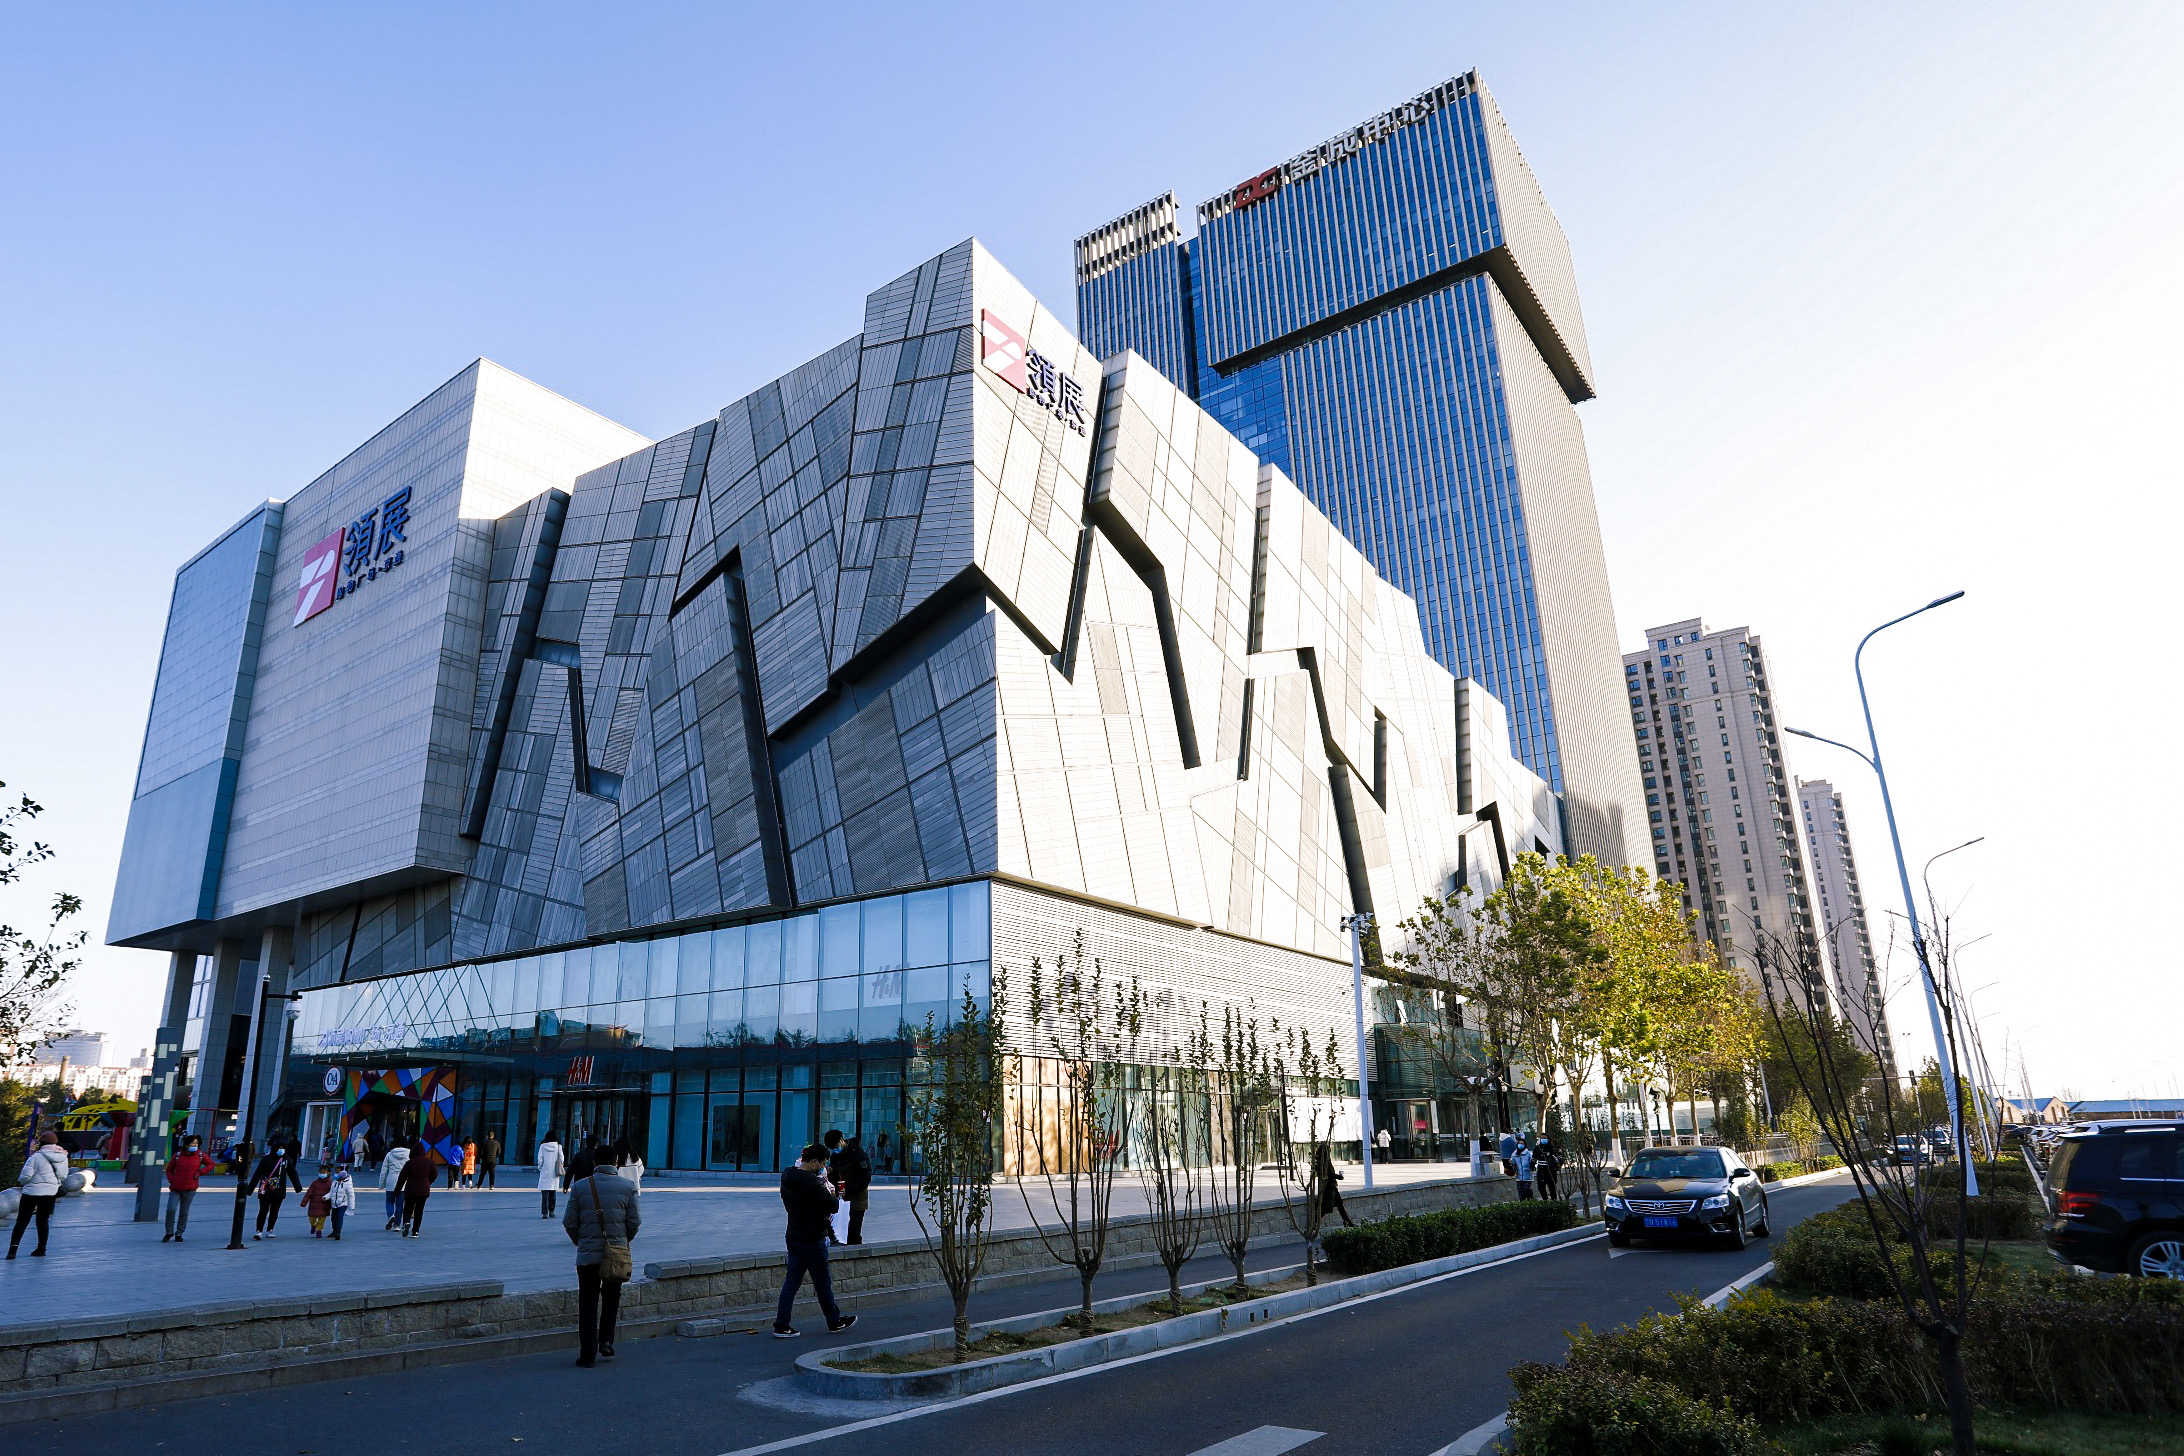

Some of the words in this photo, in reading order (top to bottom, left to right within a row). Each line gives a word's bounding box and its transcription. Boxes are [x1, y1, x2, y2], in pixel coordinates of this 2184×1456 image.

[1290, 98, 1431, 181] 金成中心
[327, 1072, 338, 1086] C&A
[567, 1056, 595, 1086] H&M
